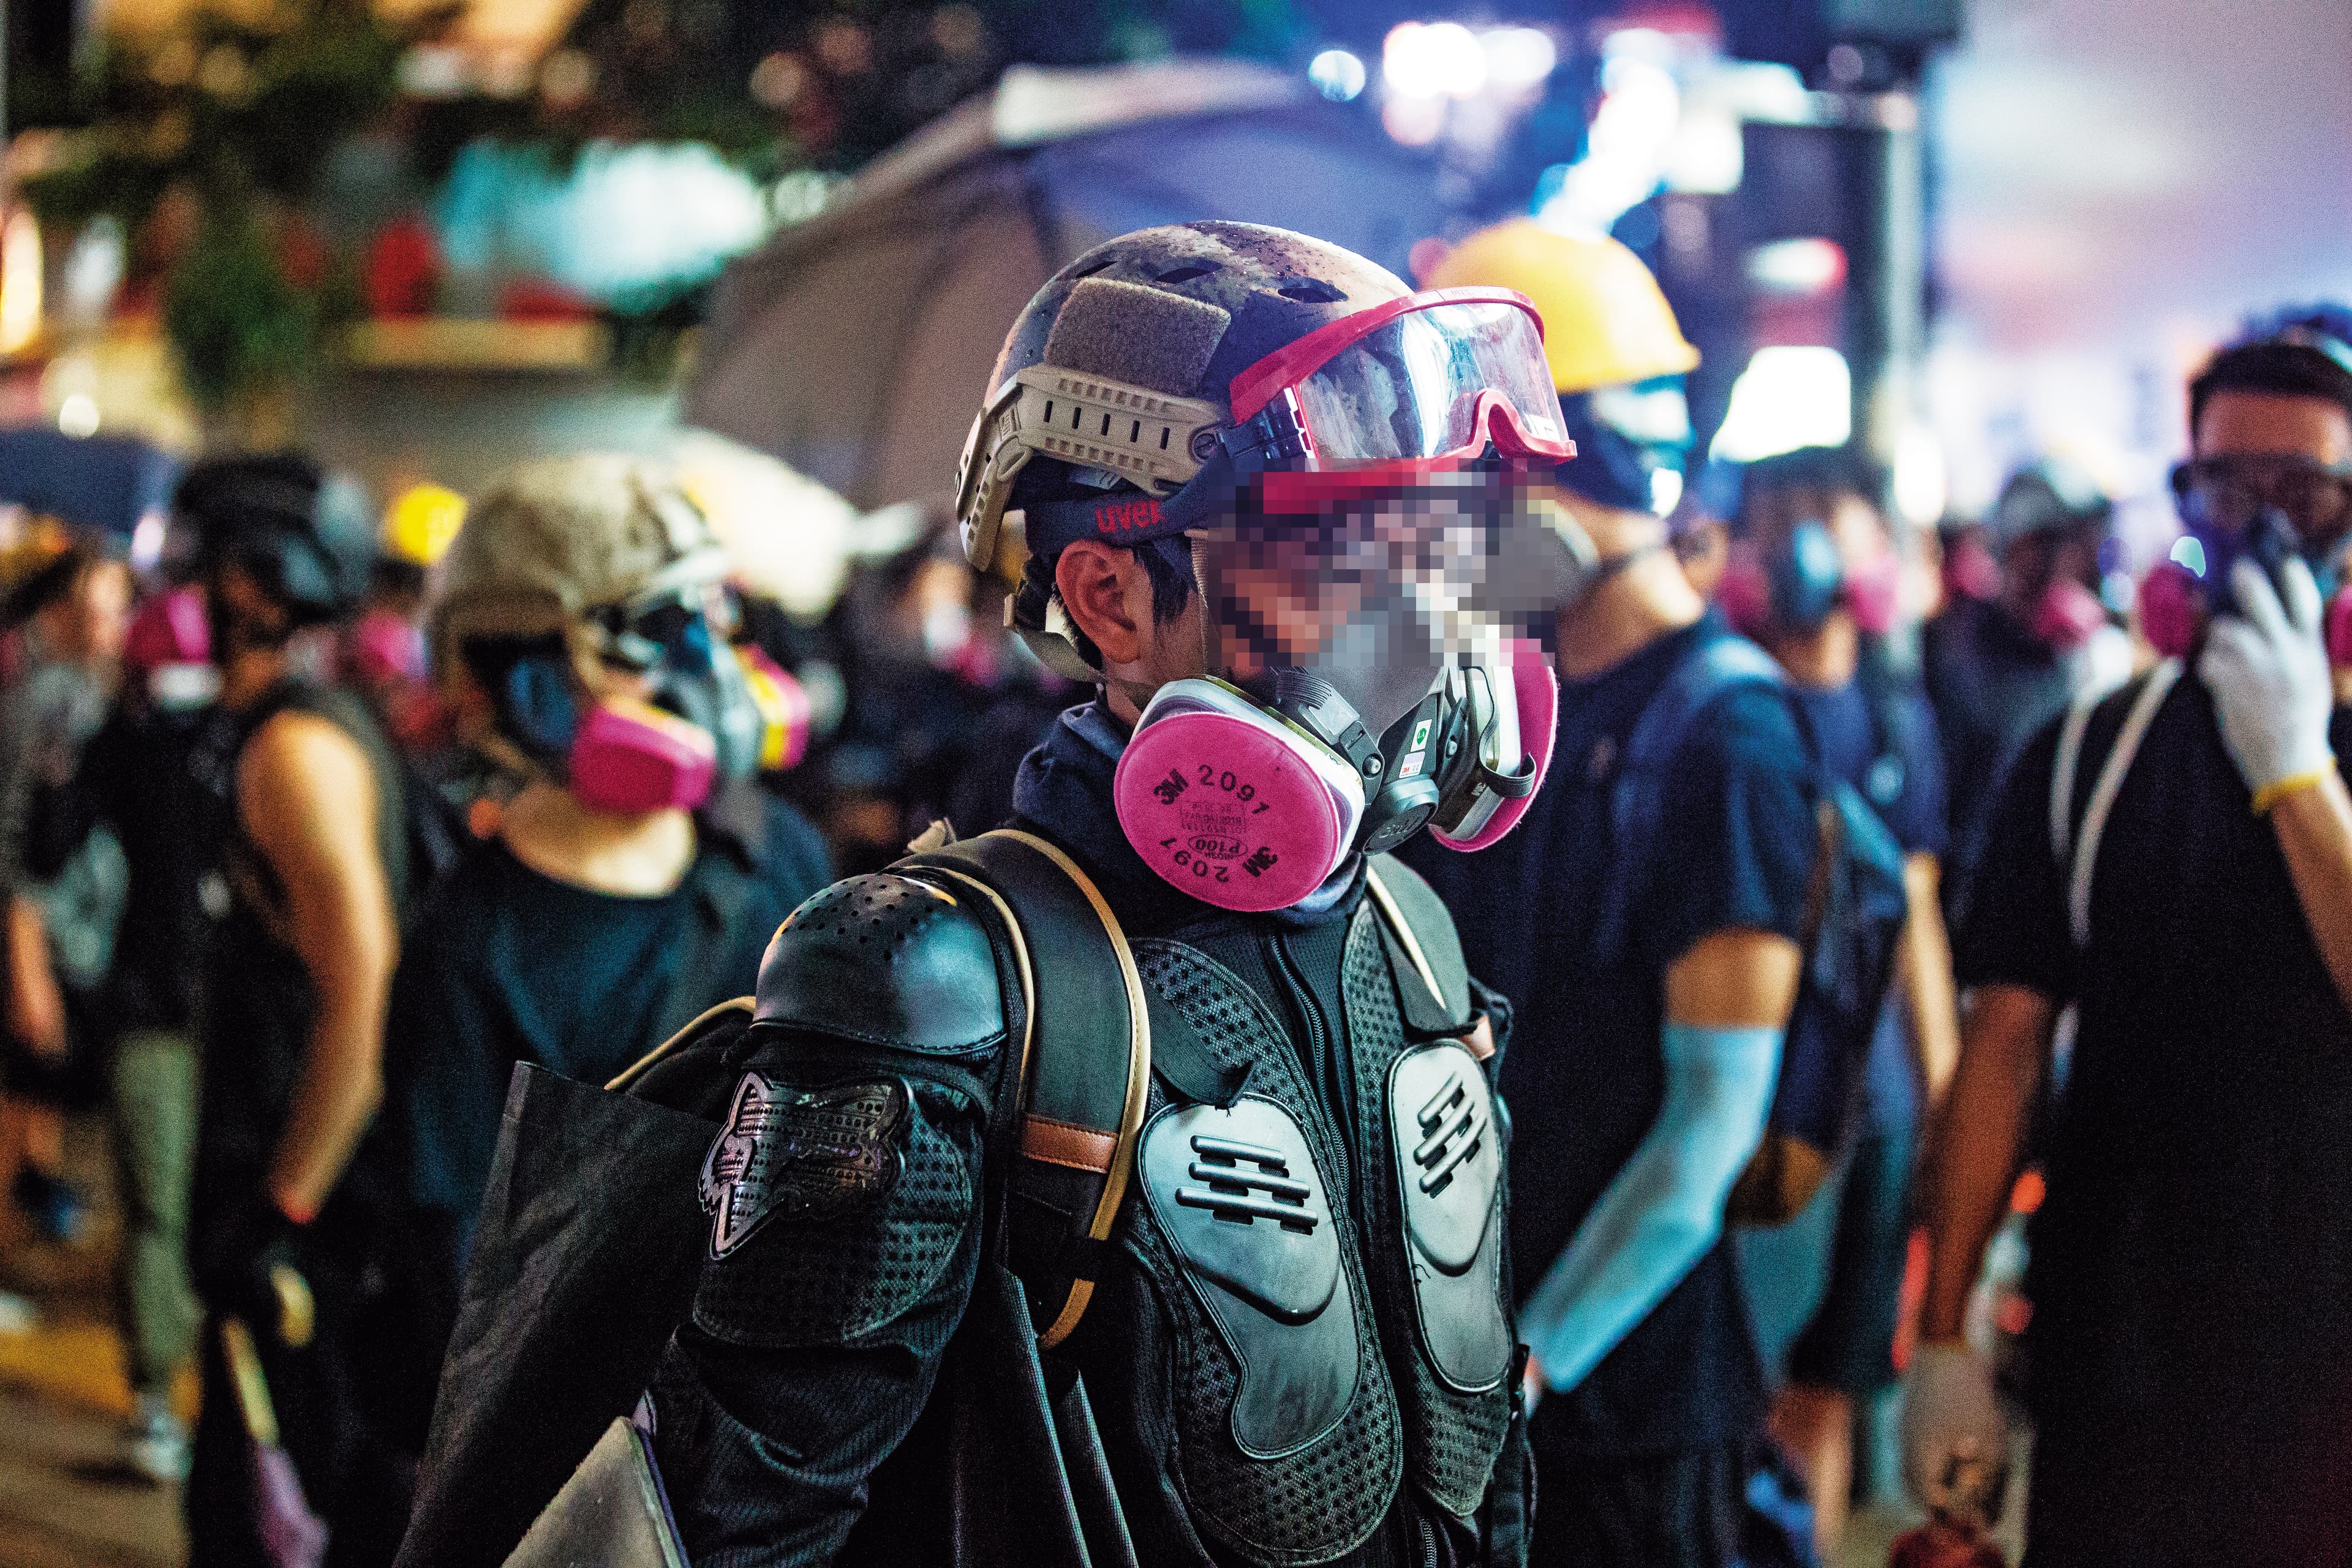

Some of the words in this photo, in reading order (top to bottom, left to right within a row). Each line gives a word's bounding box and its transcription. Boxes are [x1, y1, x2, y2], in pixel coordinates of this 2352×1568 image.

[1153, 768, 1189, 805] 3M
[1198, 764, 1270, 815] 2091
[1159, 837, 1229, 883] 2091
[1195, 839, 1240, 854] P100
[1242, 846, 1278, 878] 3M
